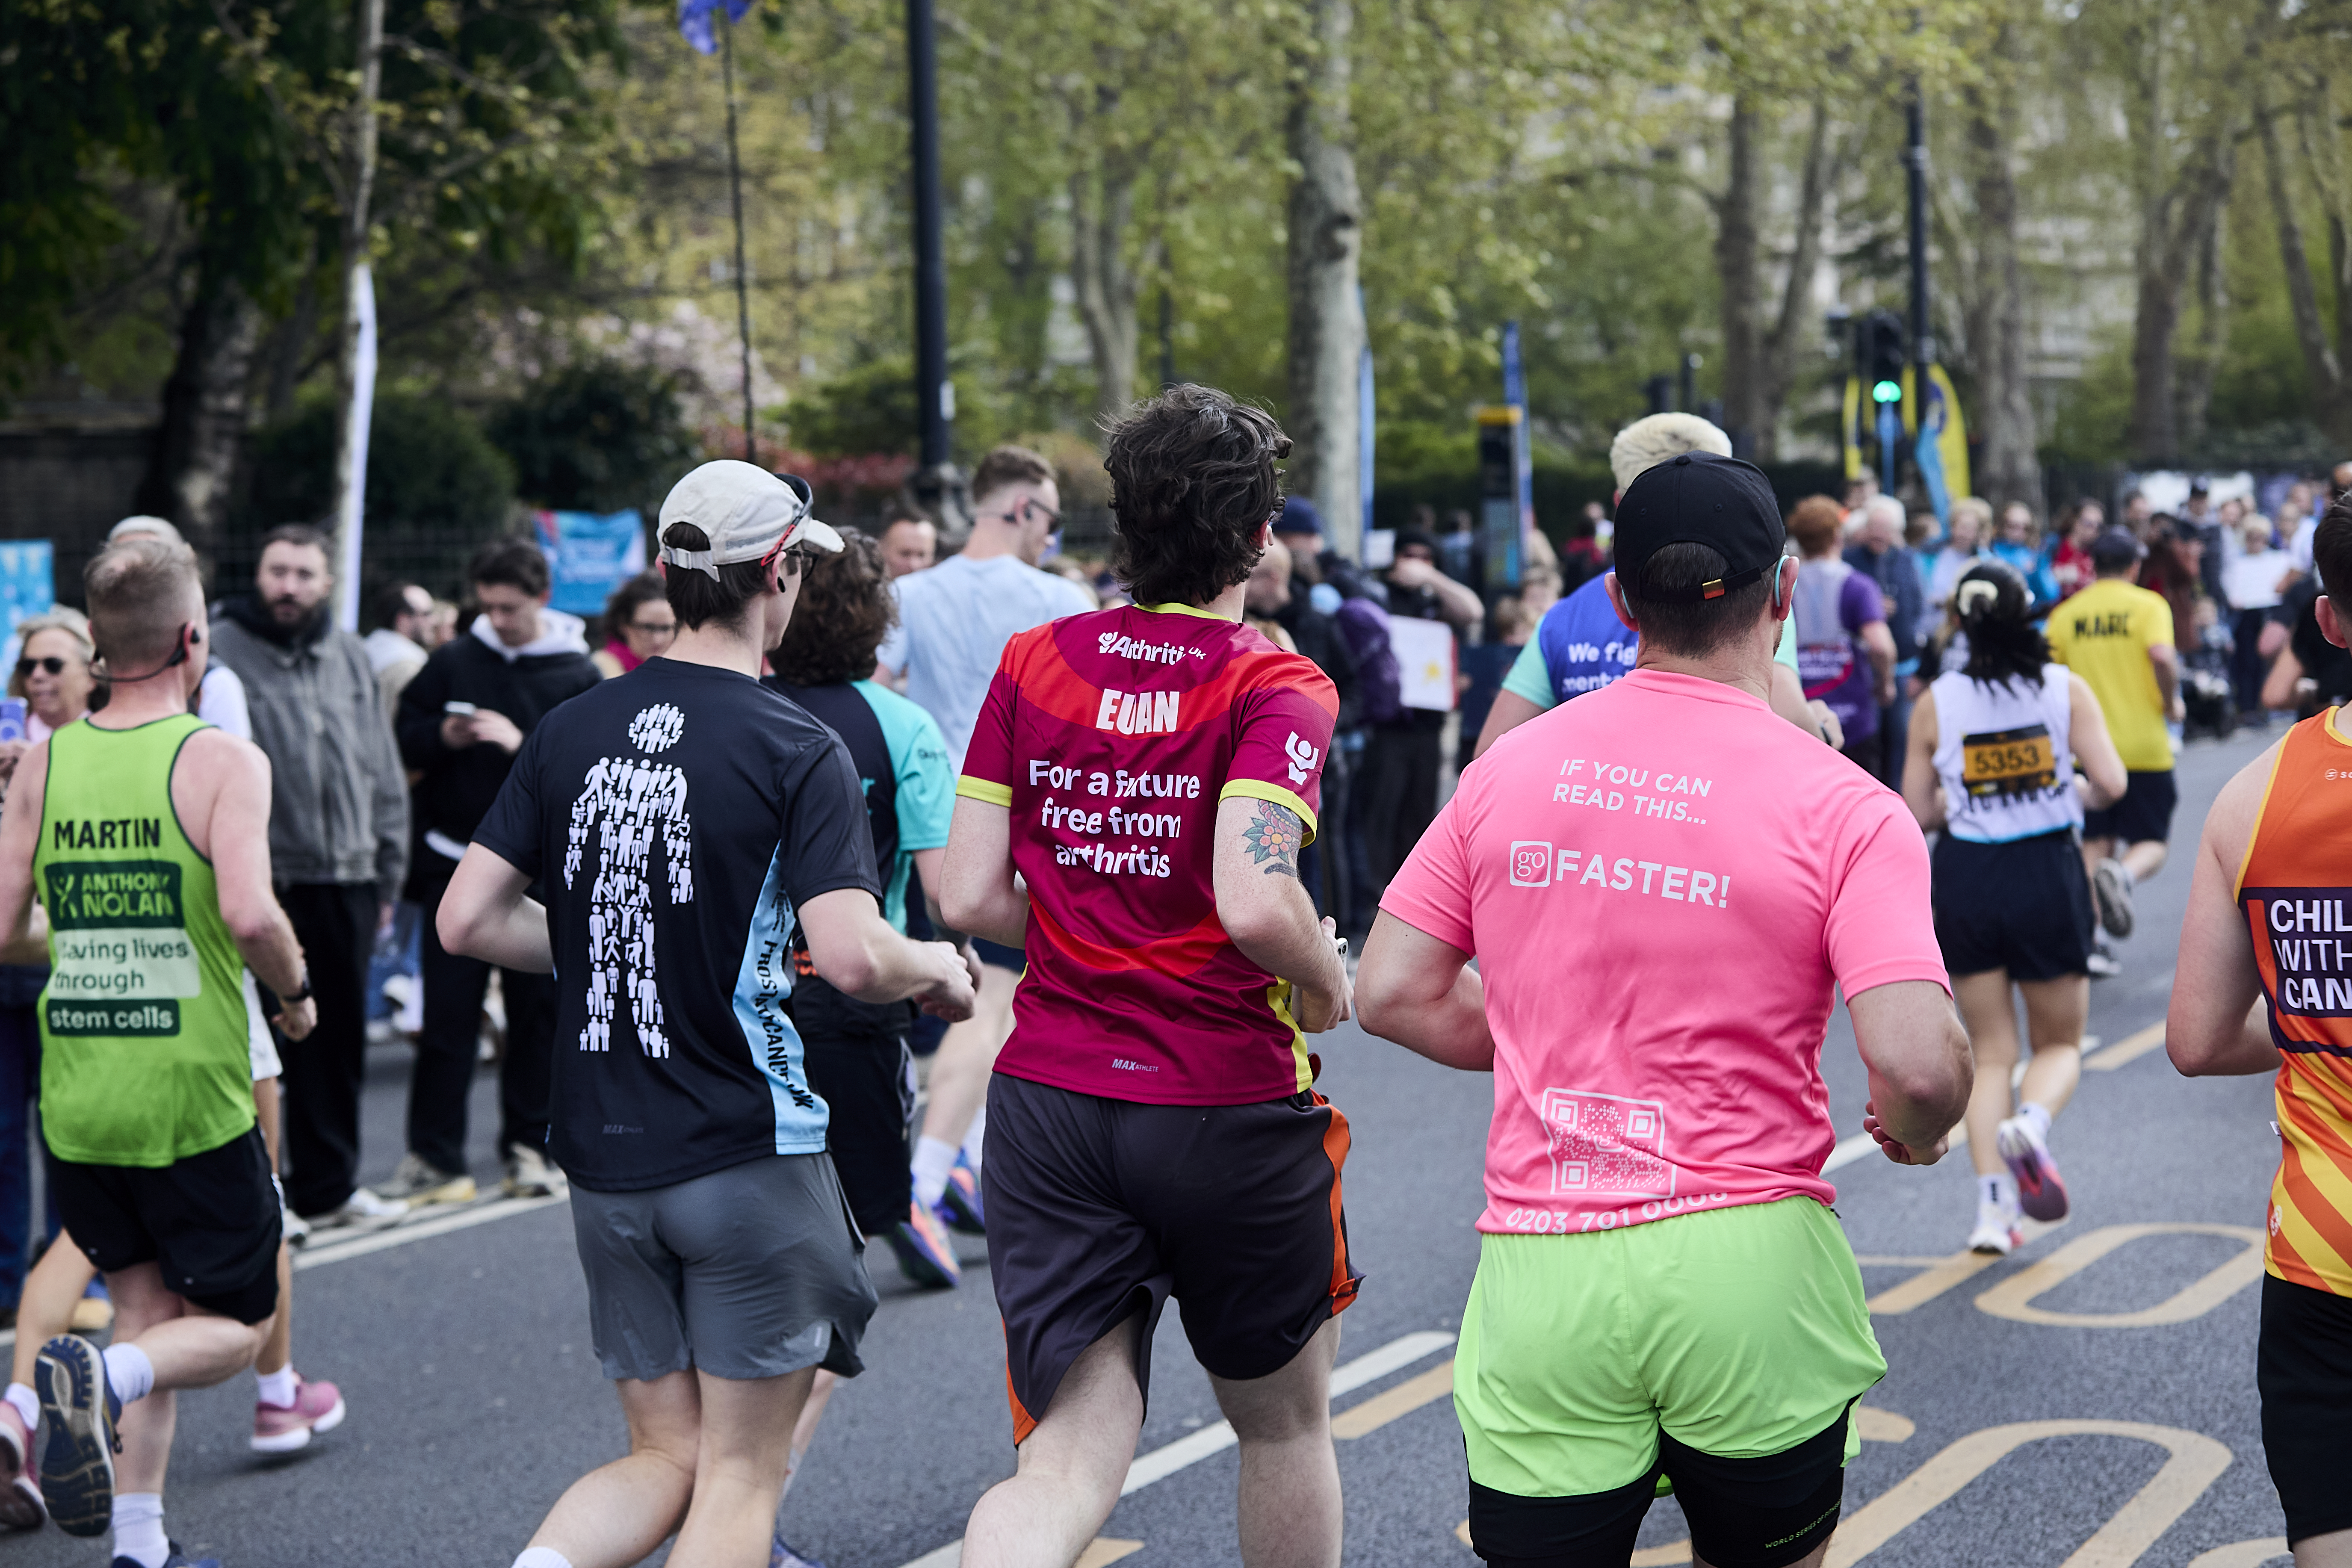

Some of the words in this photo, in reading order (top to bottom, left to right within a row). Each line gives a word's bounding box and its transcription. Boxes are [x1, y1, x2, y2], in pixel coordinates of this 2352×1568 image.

[1108, 635, 1187, 665] Arthriti
[1188, 647, 1207, 660] UK
[1568, 642, 1600, 664] We
[1604, 641, 1639, 666] fig
[1096, 688, 1180, 735] EUAN
[1975, 744, 2040, 774] 5353
[1029, 759, 1081, 790] For
[1087, 772, 1109, 796] a
[1114, 770, 1200, 799] future
[1560, 759, 1585, 776] IF
[1593, 761, 1649, 787] YOU
[1655, 773, 1712, 797] CAN
[1041, 797, 1102, 834] free
[1108, 806, 1181, 838] from
[1552, 783, 1624, 811] READ
[1633, 795, 1707, 824] THIS...
[54, 818, 161, 850] MARTIN
[1055, 843, 1171, 878] arthritis
[1516, 851, 1545, 877] go
[1555, 848, 1731, 909] FASTER!
[82, 892, 176, 918] NOLAN
[63, 939, 126, 964] aving
[133, 938, 189, 959] lives
[54, 968, 145, 995] through
[50, 1007, 110, 1029] stem
[114, 1005, 173, 1029] cells
[1112, 1058, 1137, 1071] MAX
[1505, 1207, 1568, 1234] 0203
[1579, 1207, 1631, 1233] 701
[1765, 1535, 1794, 1548] WORLD
